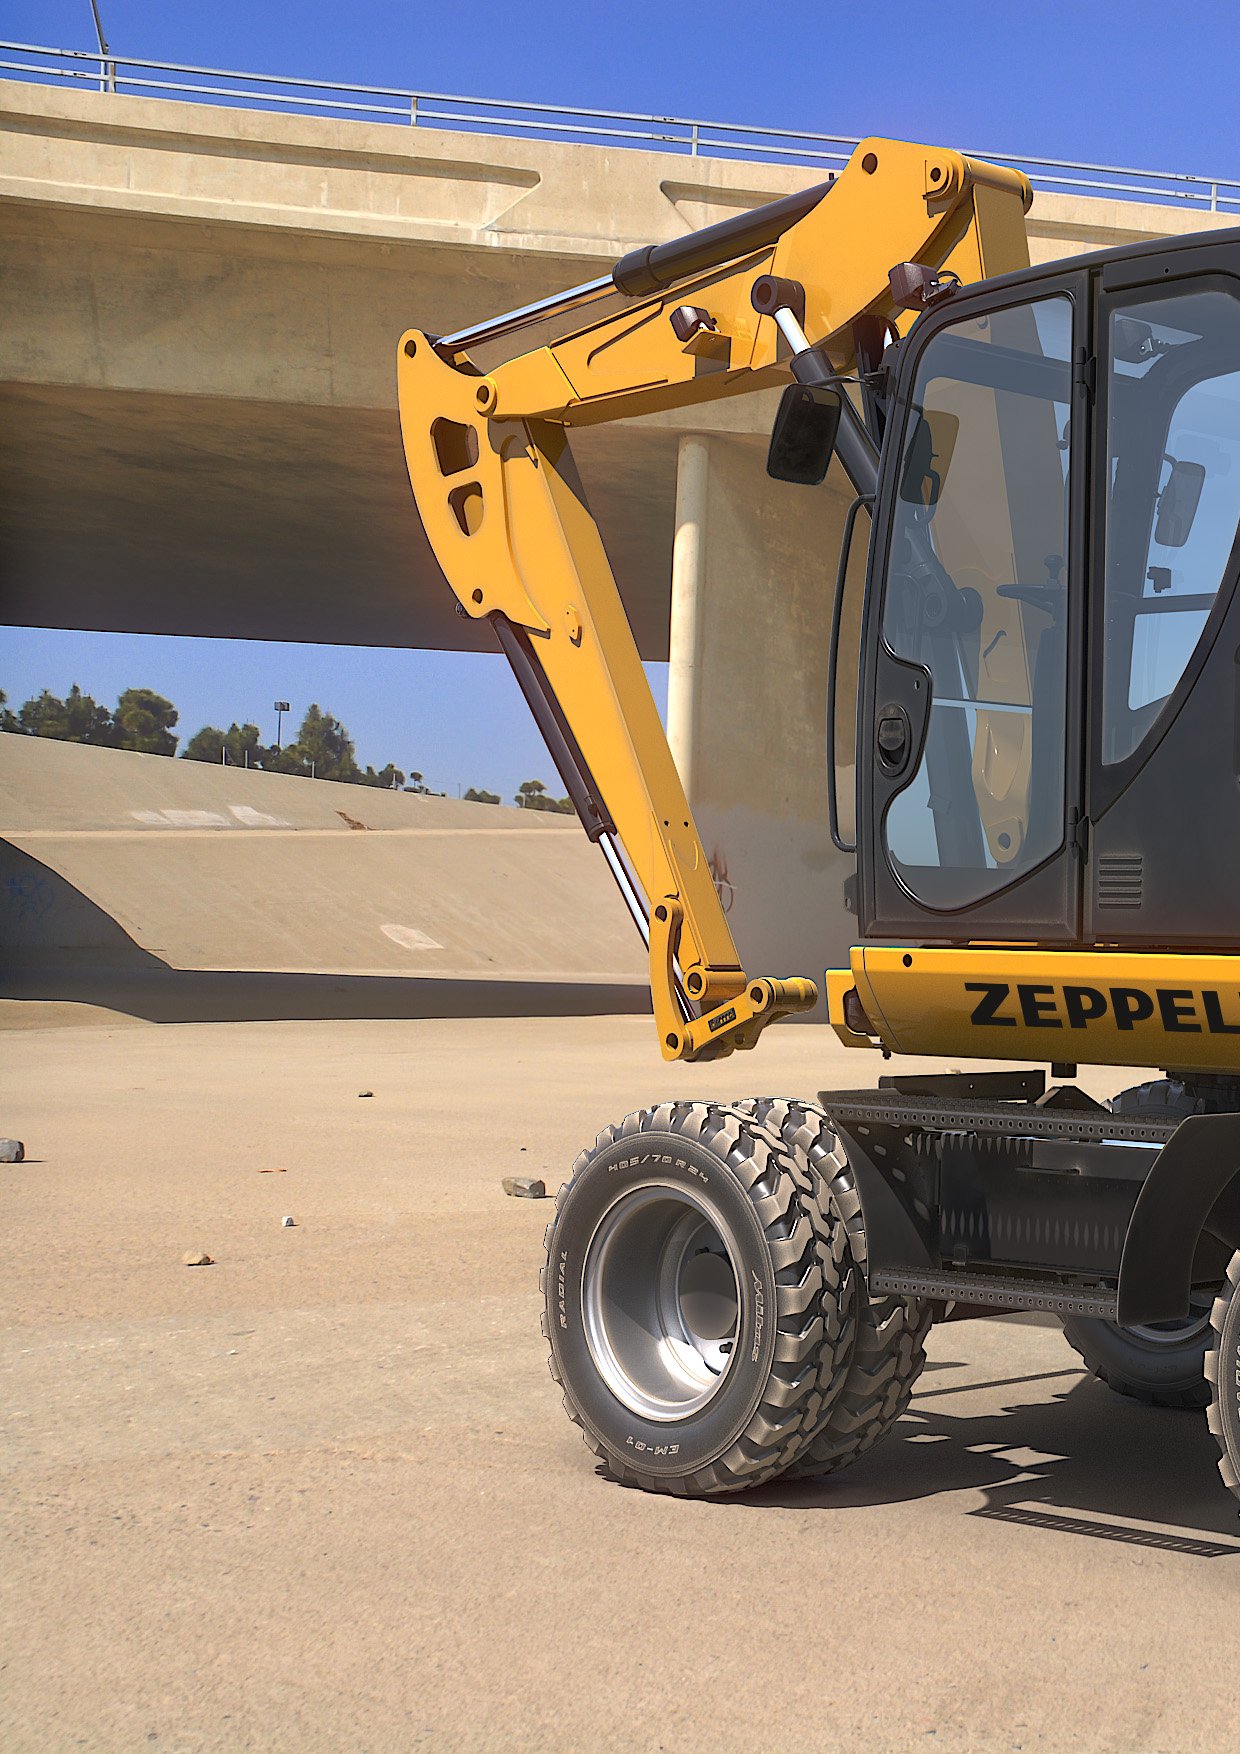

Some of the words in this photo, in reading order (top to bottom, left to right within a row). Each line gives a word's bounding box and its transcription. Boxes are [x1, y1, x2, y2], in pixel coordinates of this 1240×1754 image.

[608, 1154, 672, 1172] 405/70
[675, 1159, 687, 1169] R
[687, 1165, 709, 1183] 24
[558, 1251, 567, 1329] RADIAL
[626, 1435, 680, 1455] EM-01
